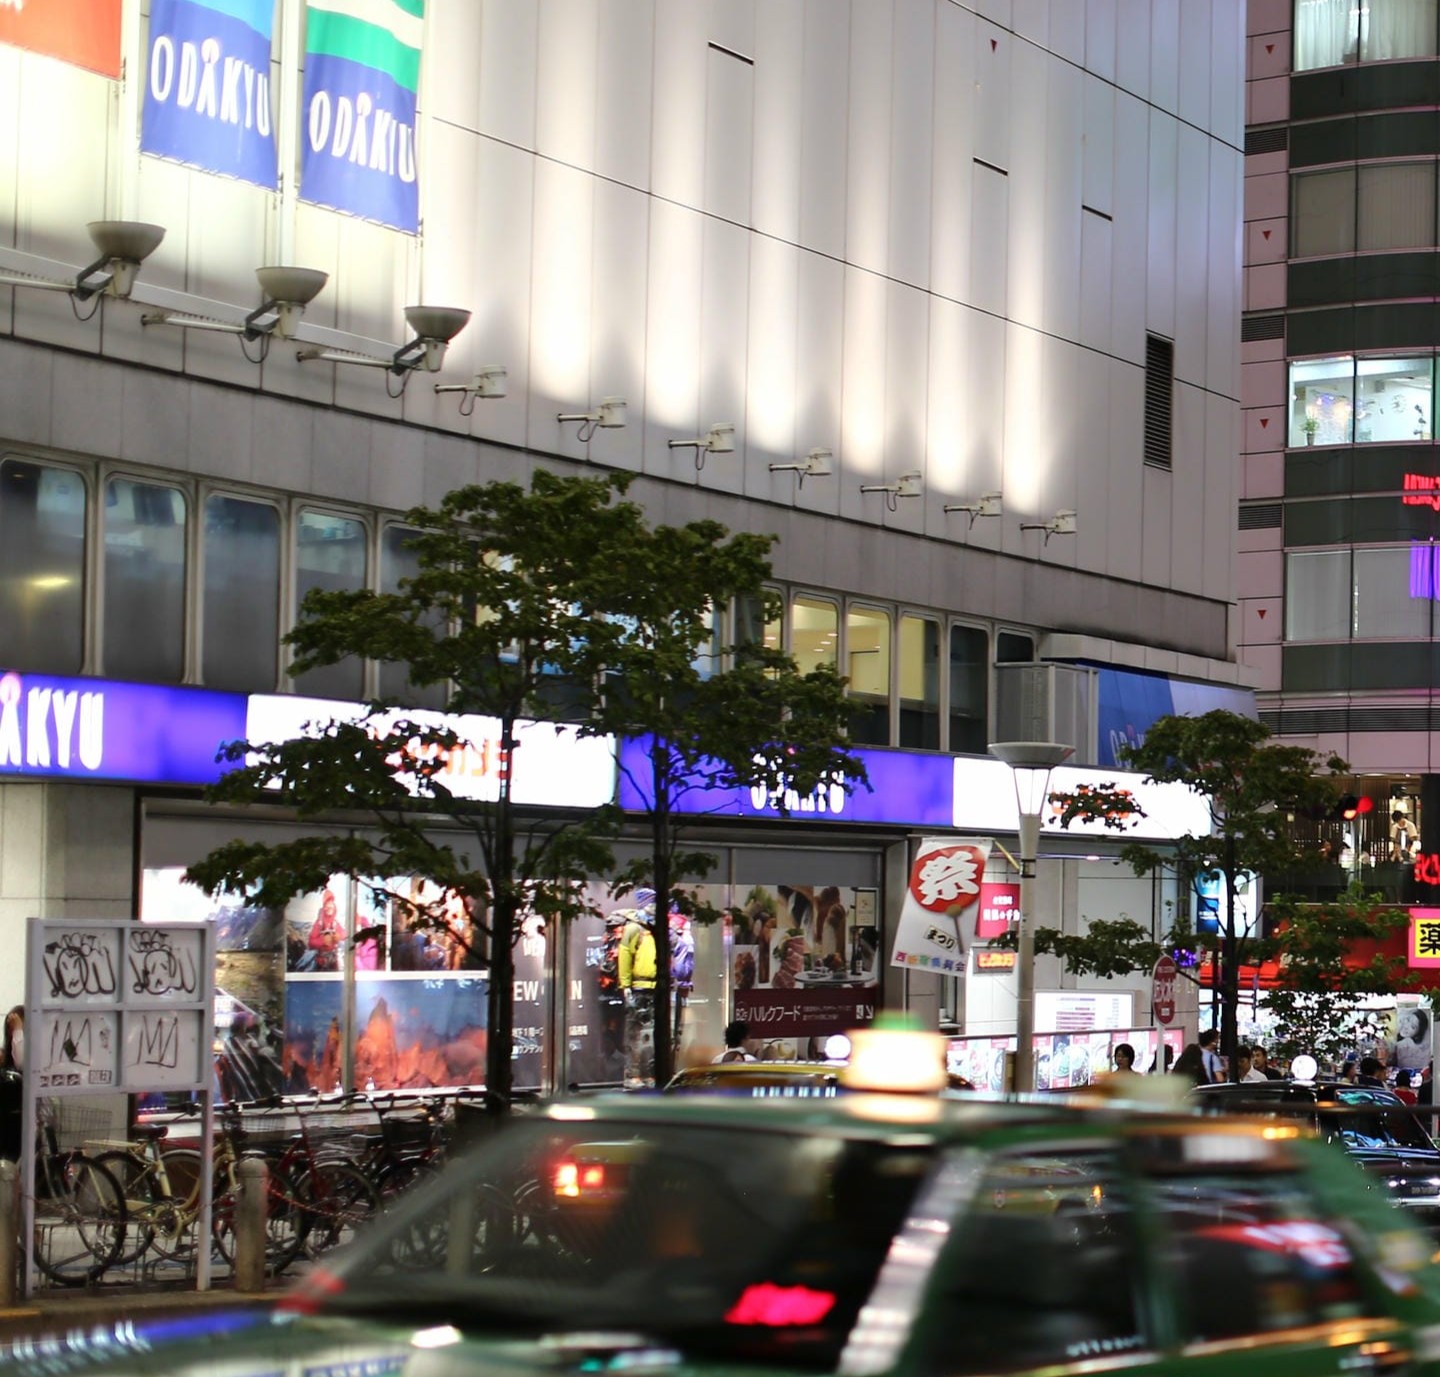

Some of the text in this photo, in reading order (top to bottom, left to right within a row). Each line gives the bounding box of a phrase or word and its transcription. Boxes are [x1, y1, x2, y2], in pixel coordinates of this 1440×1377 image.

[149, 35, 272, 138] ODAKYU
[308, 91, 417, 183] ODAKYU
[919, 851, 981, 907] 祭
[927, 929, 955, 949] まつり
[512, 980, 538, 1002] EW
